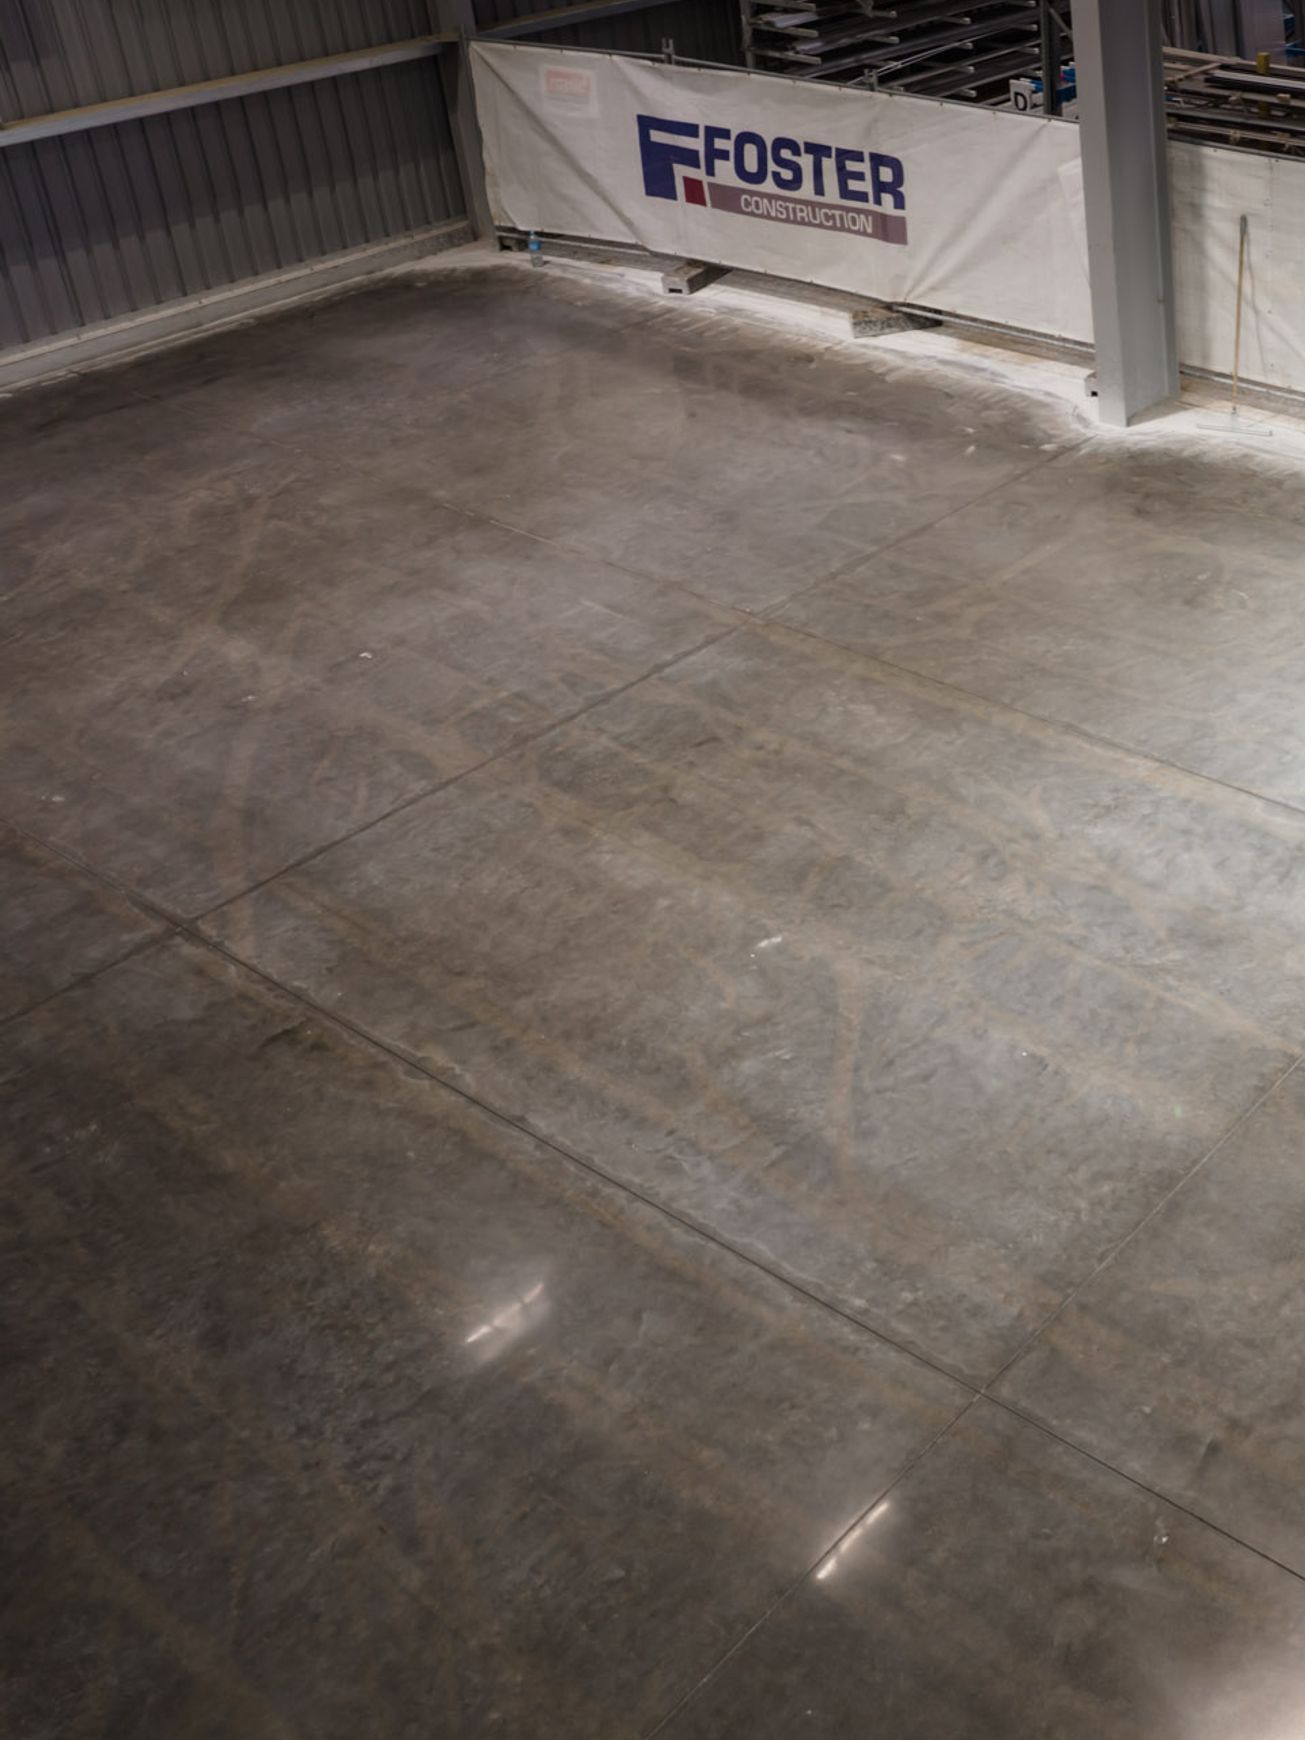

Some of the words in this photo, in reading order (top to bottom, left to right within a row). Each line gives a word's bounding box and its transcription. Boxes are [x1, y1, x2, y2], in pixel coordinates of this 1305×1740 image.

[1014, 91, 1028, 112] D
[703, 124, 906, 211] FOSTER
[740, 194, 873, 234] CONSTRUCTION
